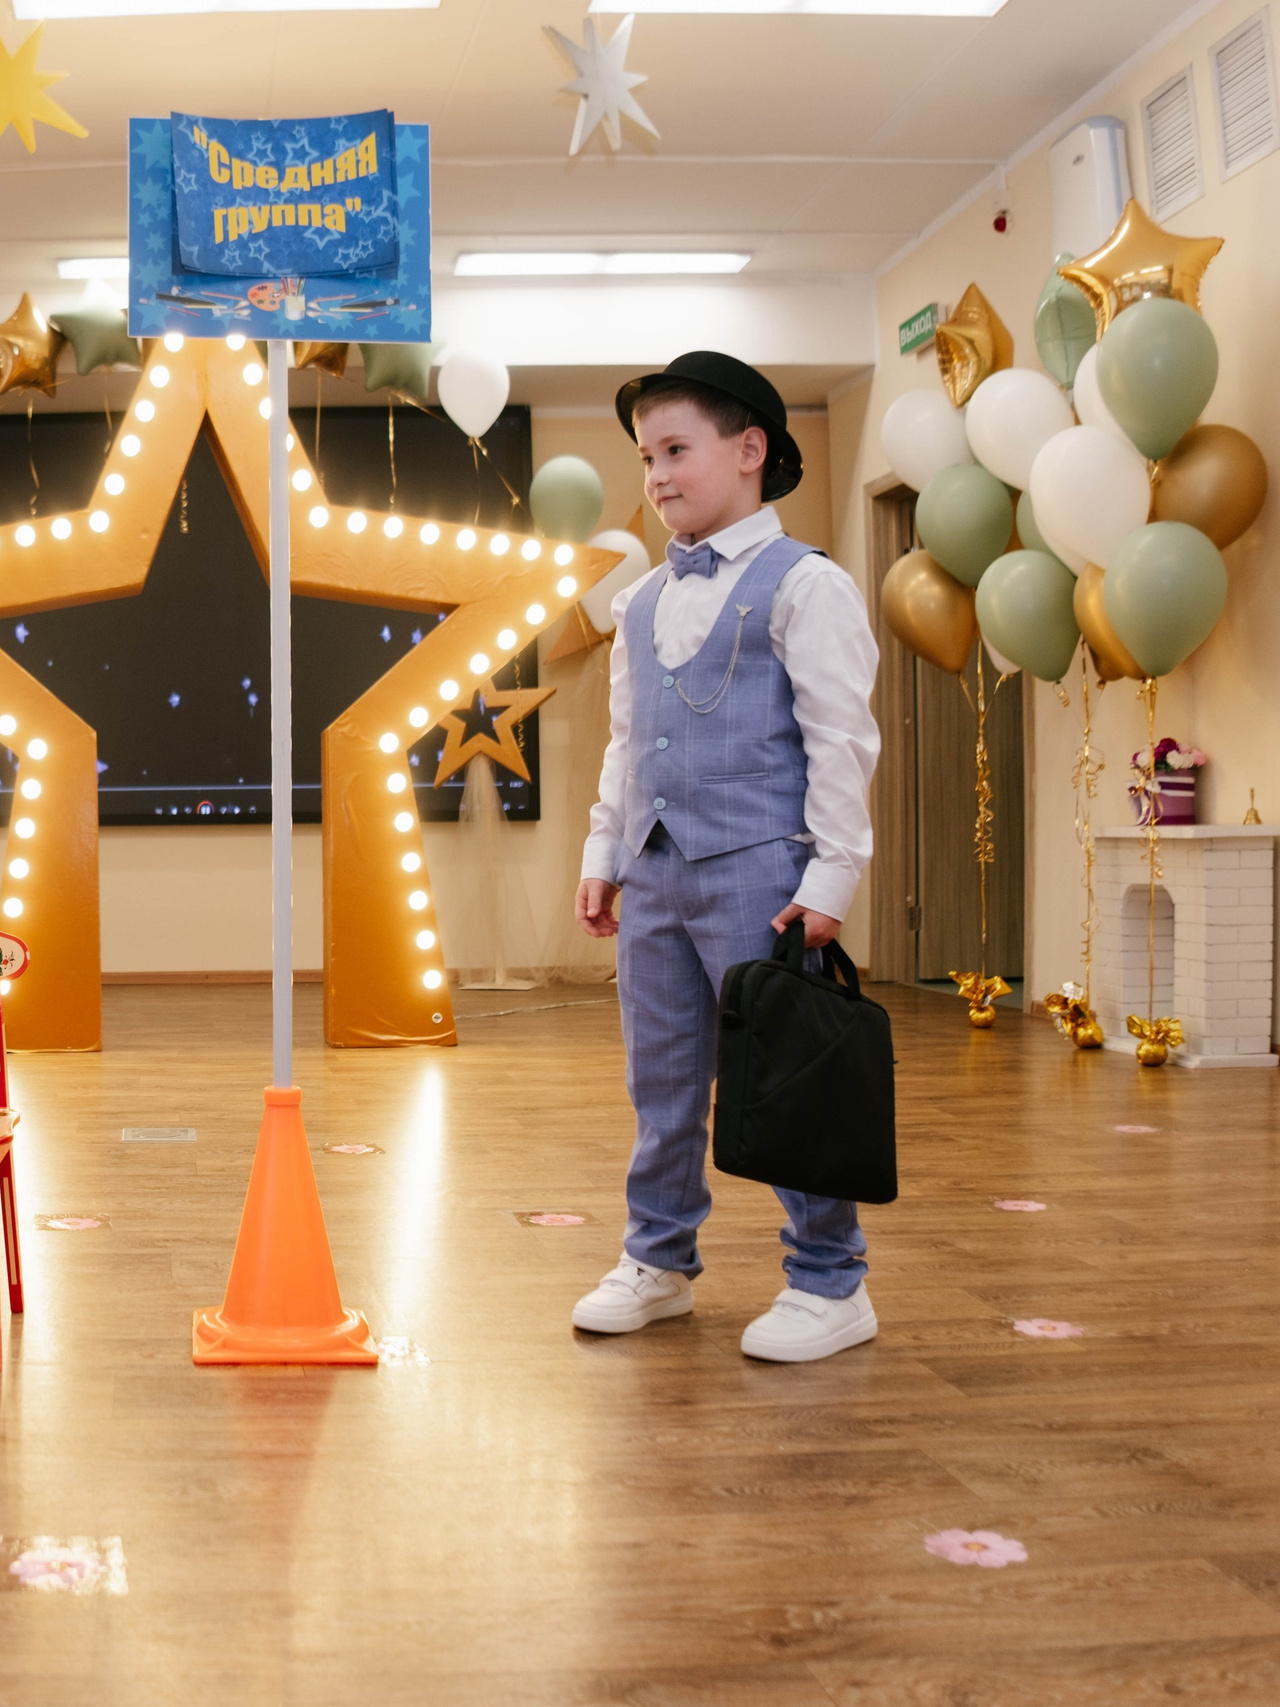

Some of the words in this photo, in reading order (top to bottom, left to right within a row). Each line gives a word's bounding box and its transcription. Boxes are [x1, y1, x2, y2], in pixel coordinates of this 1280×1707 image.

[193, 125, 377, 192] "Средняя
[213, 197, 361, 244] группа"
[900, 310, 932, 347] ВЫХОД
